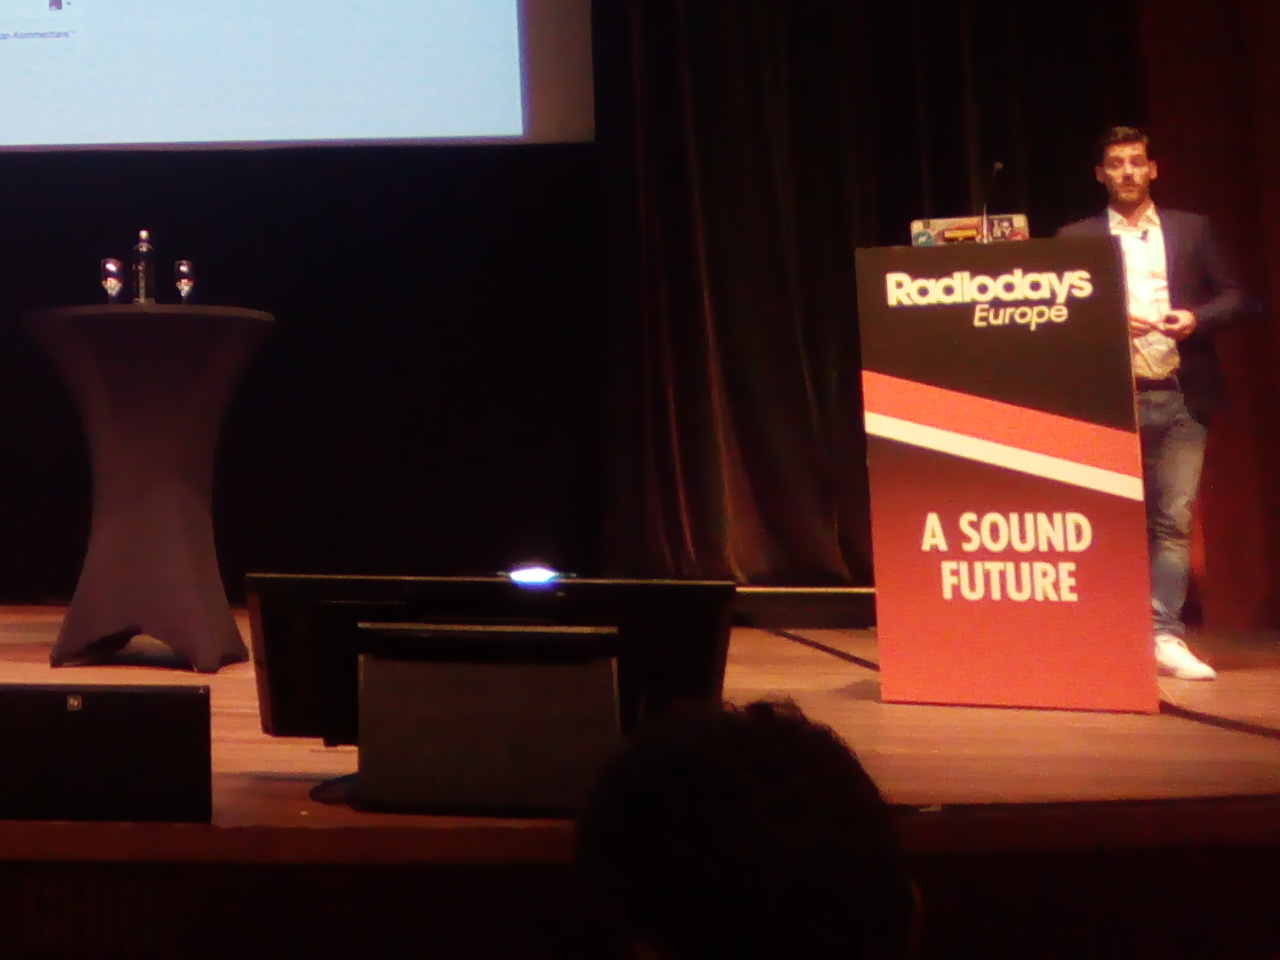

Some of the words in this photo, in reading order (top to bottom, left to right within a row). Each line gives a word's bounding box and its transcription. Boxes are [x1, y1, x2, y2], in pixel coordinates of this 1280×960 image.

[885, 268, 1094, 307] Radiodays
[973, 303, 1068, 331] Europe
[921, 512, 948, 552] A
[959, 511, 1092, 553] SOUND
[941, 560, 1078, 602] FUTURE
